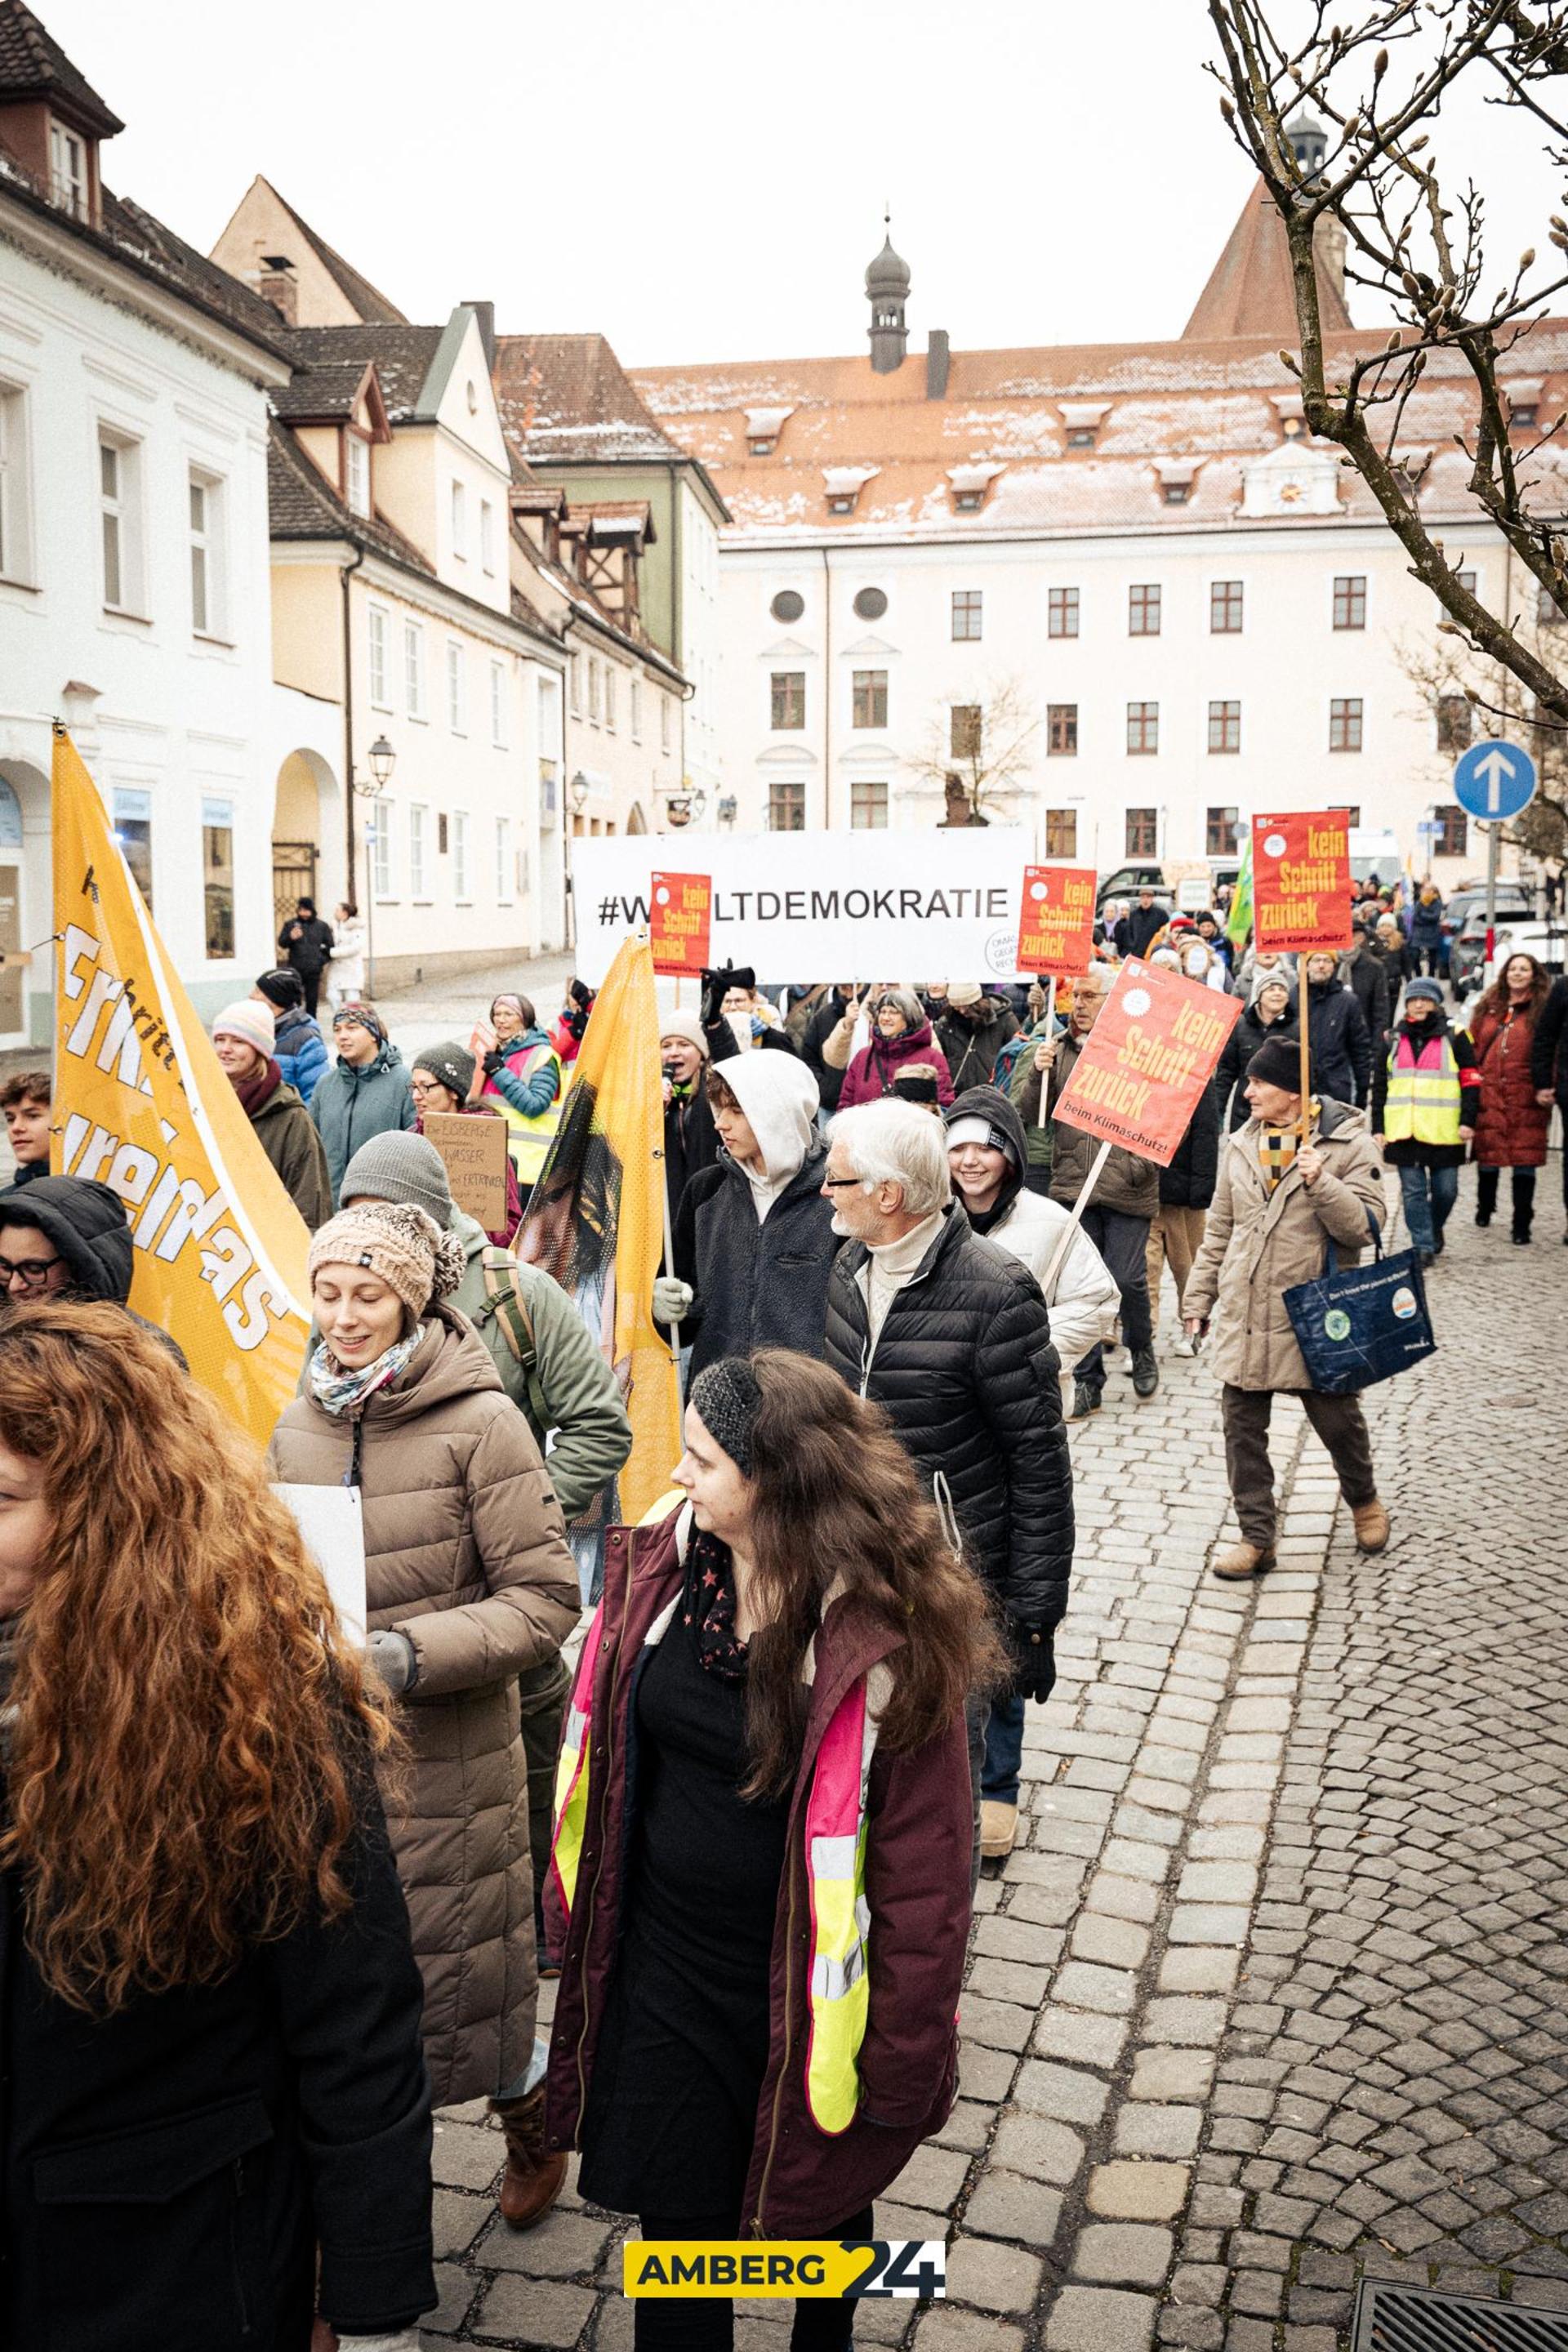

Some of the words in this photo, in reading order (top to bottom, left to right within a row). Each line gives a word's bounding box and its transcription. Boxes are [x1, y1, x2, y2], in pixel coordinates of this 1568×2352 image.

[1308, 824, 1346, 858] kein
[1063, 878, 1093, 906] kein
[1279, 860, 1337, 894] Schritt
[599, 889, 1009, 925] #WLTDEMOKRATIE
[682, 883, 708, 909] kein
[662, 907, 701, 934] Schritt
[1038, 902, 1084, 932] Schritt
[1260, 896, 1319, 931] zurück
[1021, 932, 1066, 959] zurück
[1170, 998, 1226, 1054] kein
[1116, 1024, 1199, 1089] Schritt
[1071, 1062, 1152, 1122] zurück
[1063, 1100, 1093, 1121] beim
[1093, 1114, 1169, 1155] Klimaschutz!
[444, 1149, 485, 1164] WASSER
